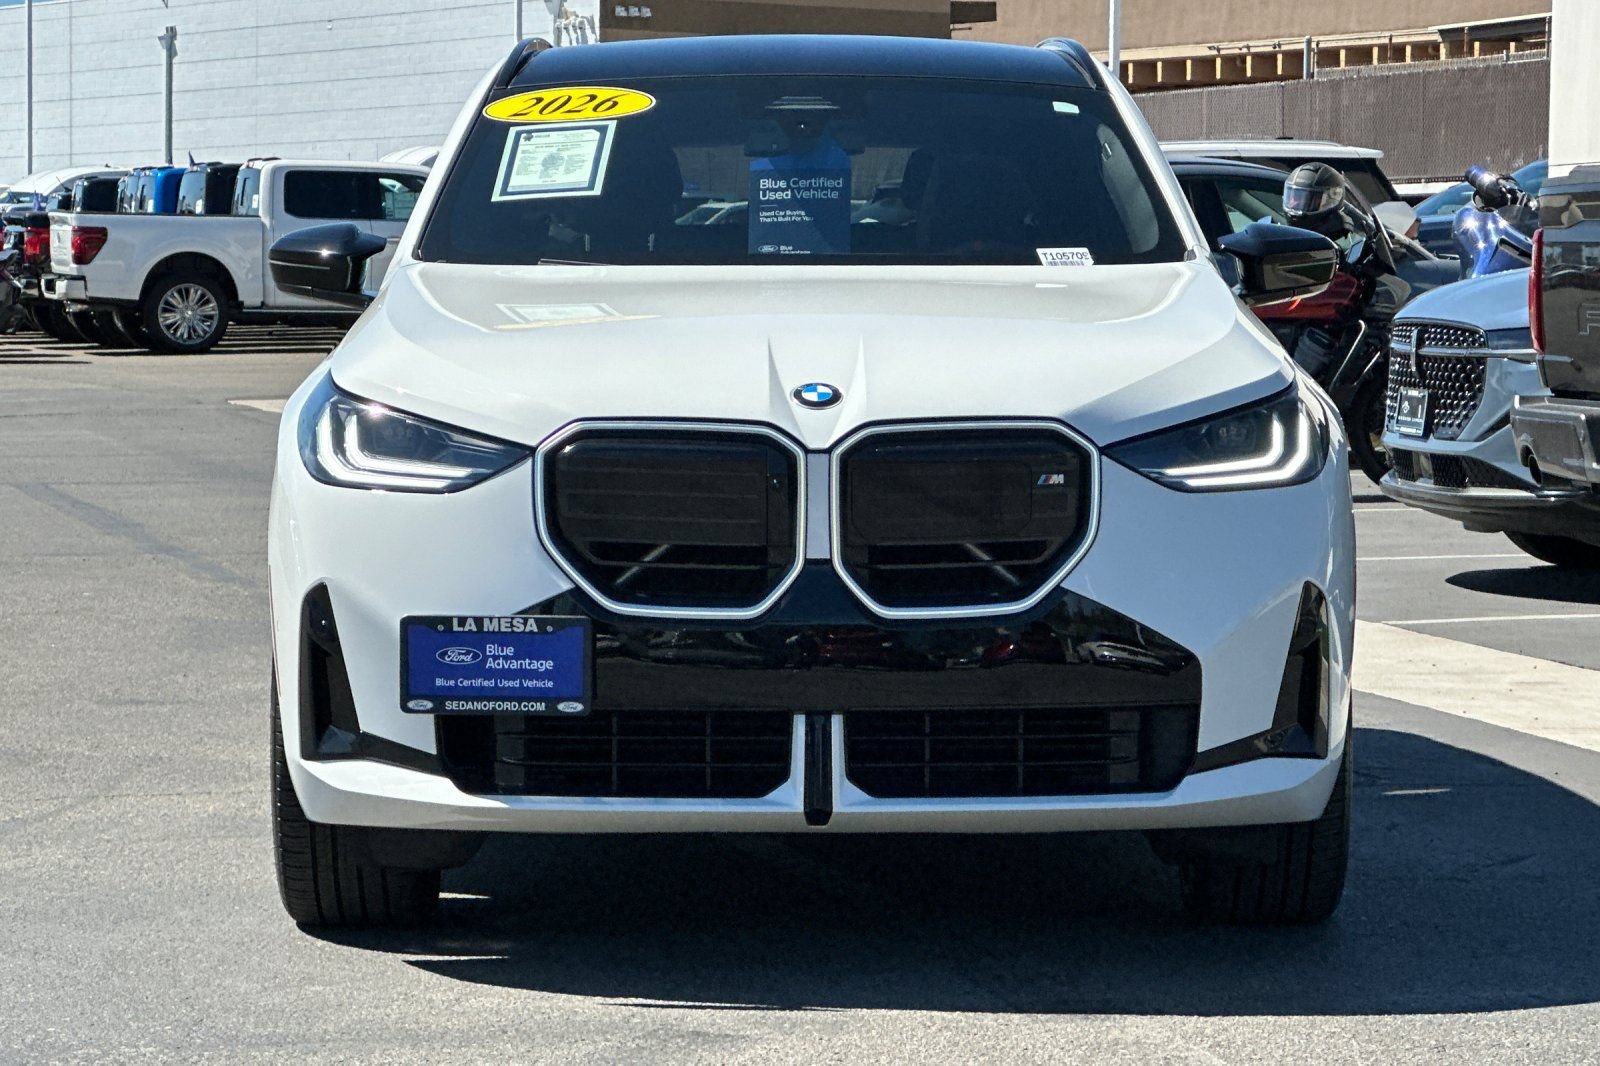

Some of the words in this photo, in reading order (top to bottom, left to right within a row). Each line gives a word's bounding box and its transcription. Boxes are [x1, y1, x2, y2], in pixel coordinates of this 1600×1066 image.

[507, 93, 629, 118] 2026
[759, 178, 787, 189] Blue
[790, 177, 843, 188] Certified
[759, 189, 791, 200] Used
[794, 188, 839, 199] Vehicle
[453, 618, 477, 632] LA
[484, 618, 538, 633] MESA
[444, 648, 473, 662] Ford
[486, 644, 514, 656] Blue
[486, 657, 554, 672] Advantage
[435, 678, 456, 687] Blue
[457, 678, 495, 687] Certified
[497, 678, 520, 687] Used
[522, 678, 554, 688] Vehicle
[445, 700, 546, 712] SEDANOFORD.COM
